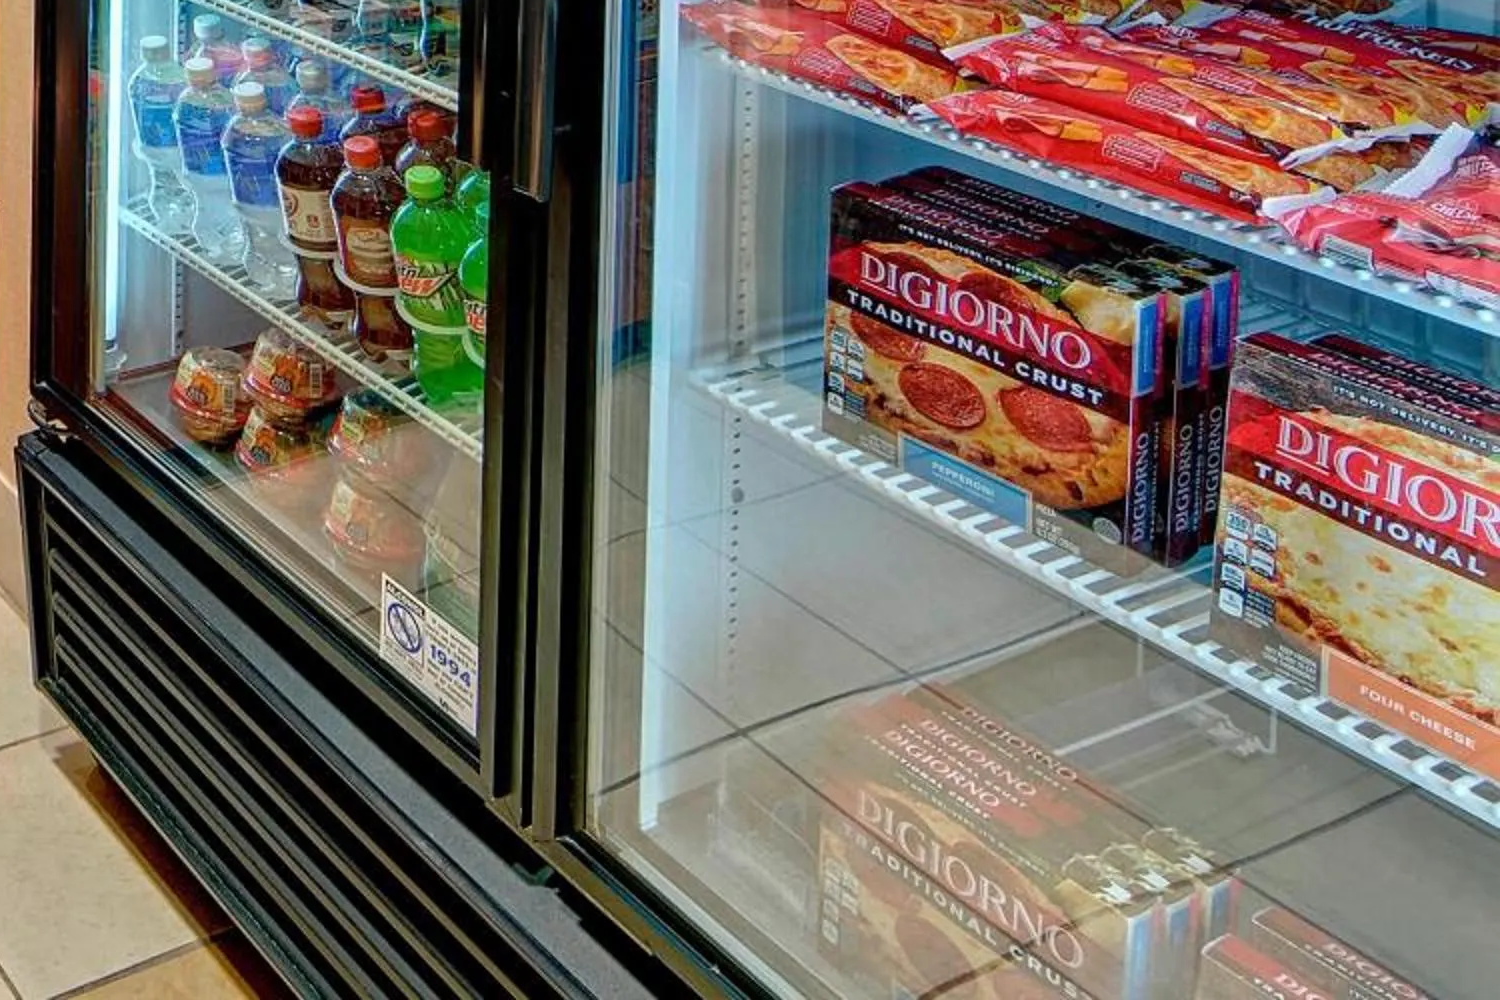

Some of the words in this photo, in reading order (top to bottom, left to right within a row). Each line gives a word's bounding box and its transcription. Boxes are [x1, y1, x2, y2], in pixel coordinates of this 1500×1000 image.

[846, 289, 1006, 369] TRADITIONAL
[1014, 360, 1105, 406] CRUST
[860, 252, 1092, 370] DIGIORNO
[1332, 384, 1356, 400] IT'S
[1359, 394, 1386, 410] NOT
[1131, 431, 1150, 544] DIGIORNO
[1174, 423, 1194, 533] DIGIORNO
[1204, 405, 1224, 513] DIGIORNO
[1253, 460, 1488, 578] TRADITIONAL
[429, 644, 472, 688] 1994
[1359, 683, 1406, 713] FOUR
[1409, 709, 1478, 752] CHEESE
[884, 729, 1001, 808] DIGIORNO
[920, 718, 1037, 797] DIGIORNO
[844, 822, 998, 947] TRADITIONAL
[856, 789, 1084, 969] DIGIORNO
